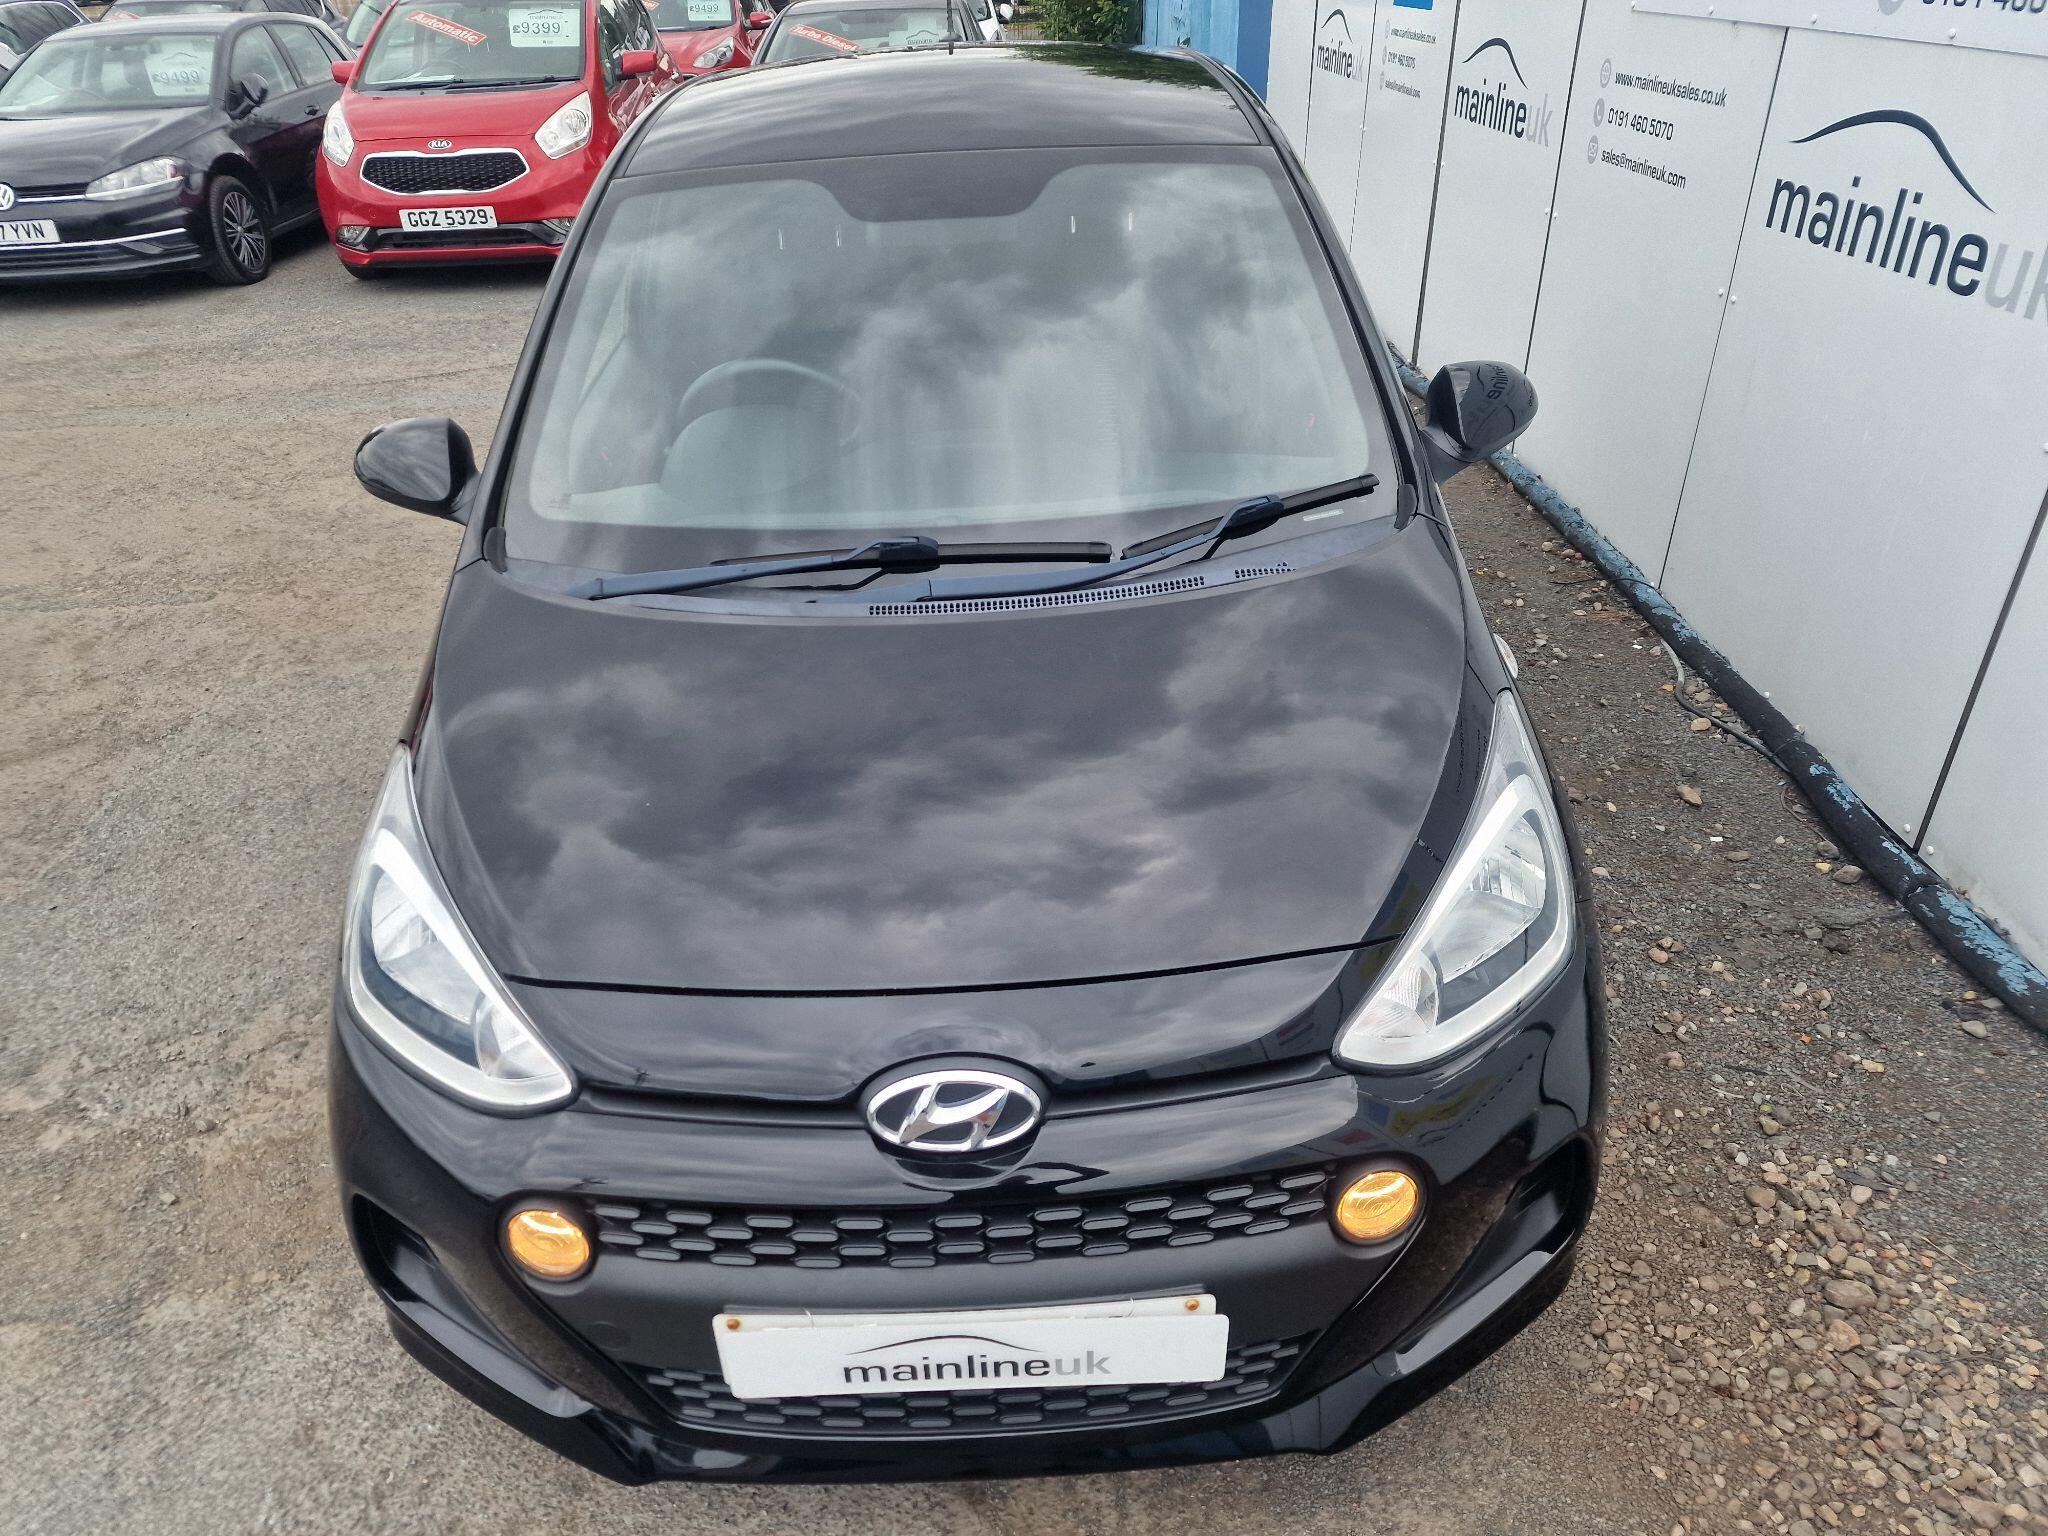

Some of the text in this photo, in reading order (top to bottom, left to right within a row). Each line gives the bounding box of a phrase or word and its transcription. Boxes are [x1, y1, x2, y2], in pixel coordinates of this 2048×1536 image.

[411, 13, 479, 42] Automatic
[512, 21, 561, 34] £9399
[794, 26, 821, 39] Turbo
[1316, 37, 1364, 83] mainlineuk
[1615, 72, 1728, 107] www.mainlineuksales.co.uk
[1454, 78, 1552, 147] mainlineuk
[1608, 107, 1674, 140] 0191 460 5070
[1601, 148, 1687, 189] sales@mainlineuk.com
[9, 222, 45, 239] YVN
[407, 209, 489, 228] GGZ 5329
[843, 1350, 1112, 1383] mainlineuk
